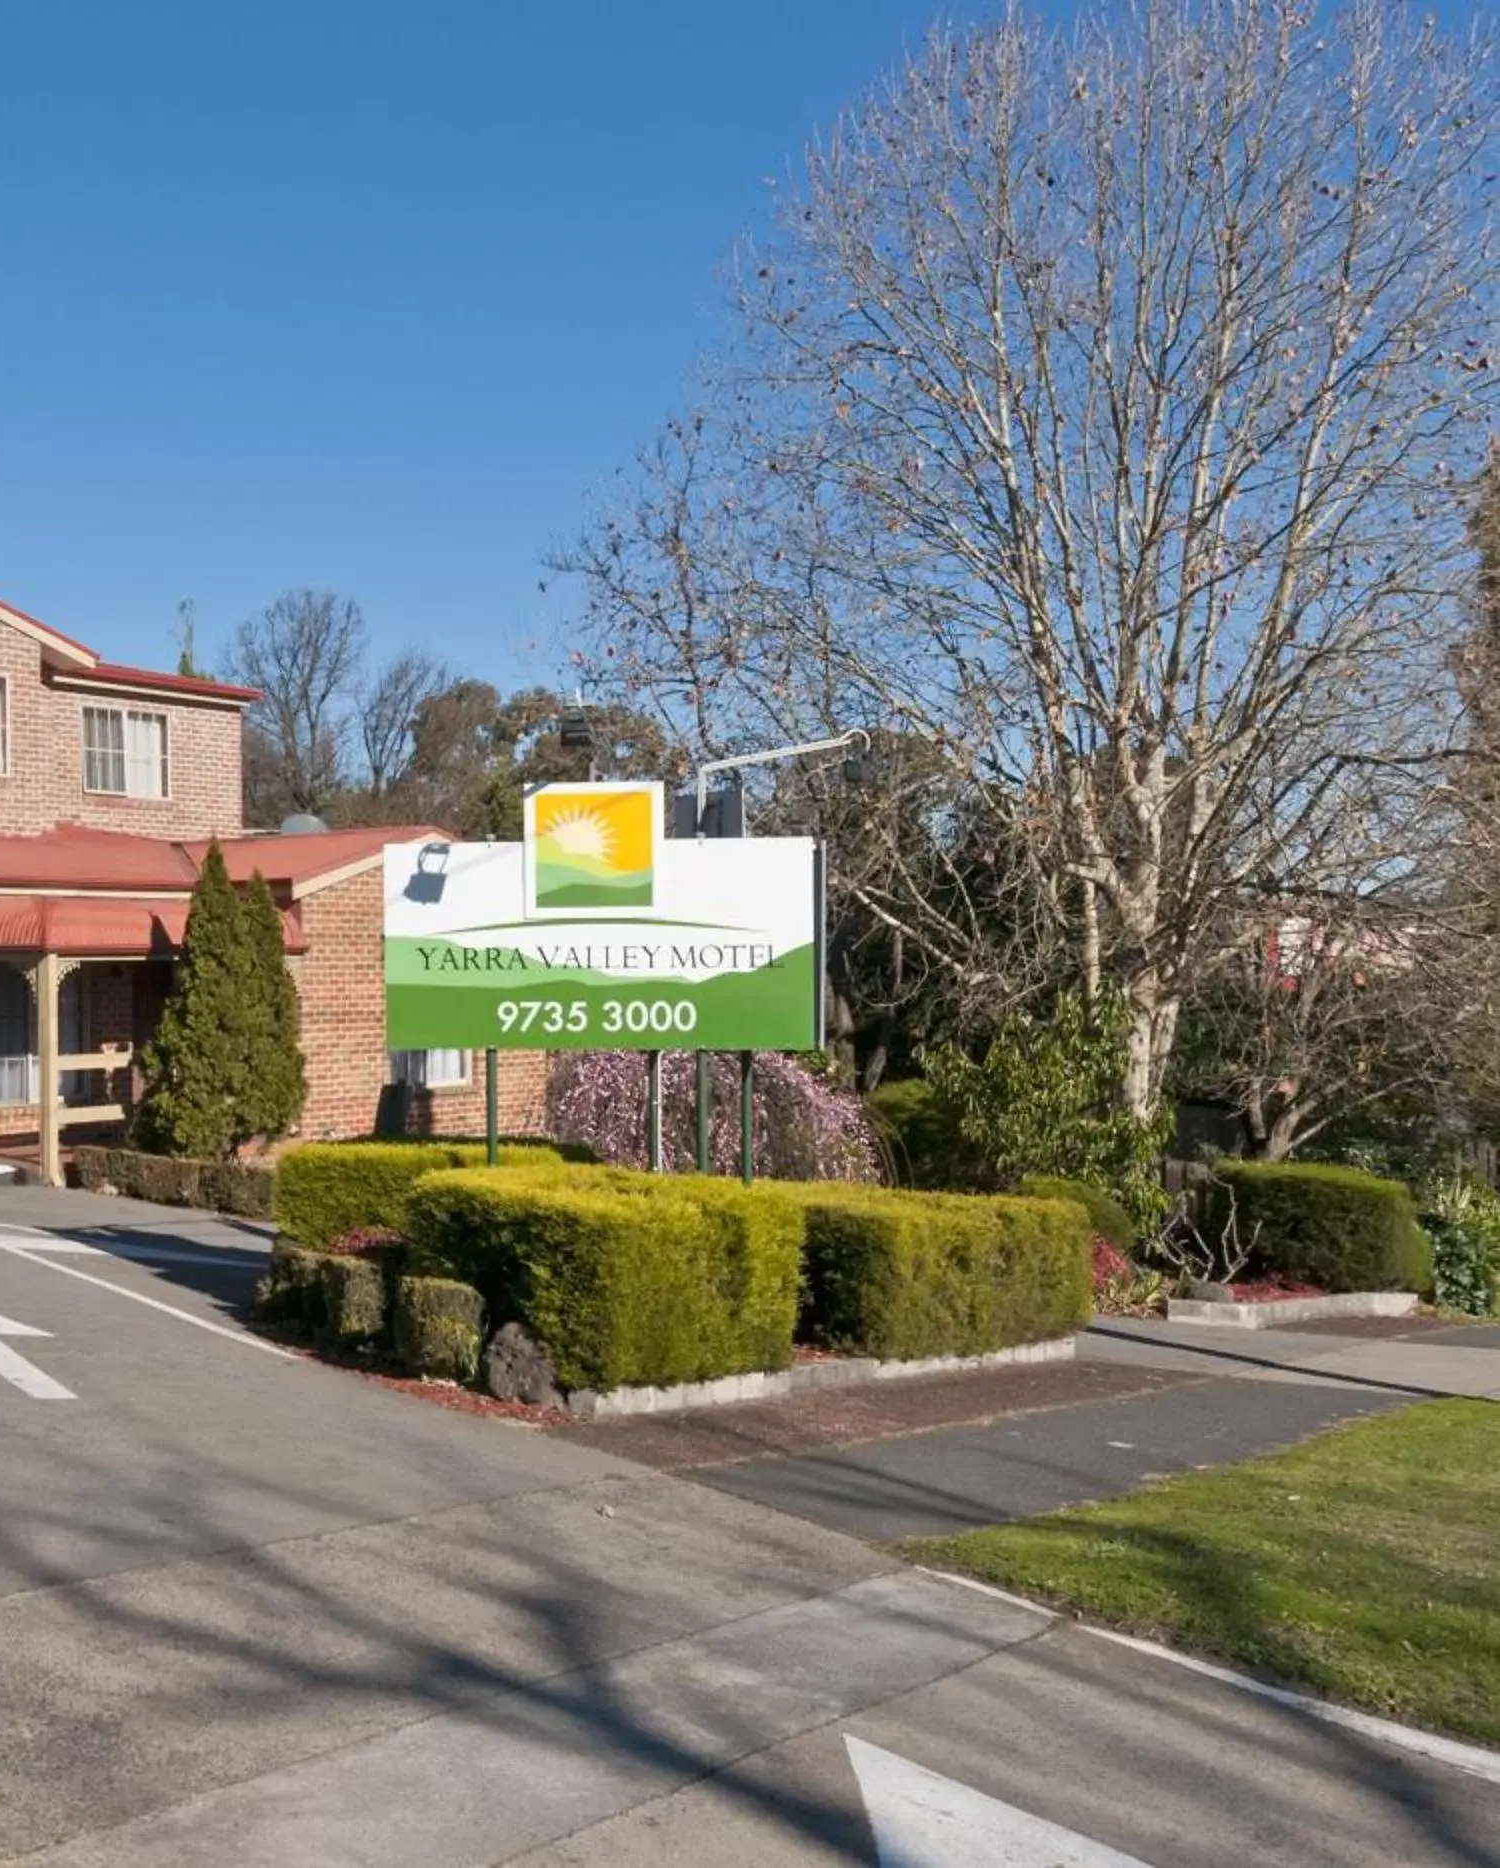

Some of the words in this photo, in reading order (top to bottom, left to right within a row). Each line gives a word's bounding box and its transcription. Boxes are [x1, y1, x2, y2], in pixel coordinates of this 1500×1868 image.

[416, 947, 528, 971] YARRA
[536, 945, 661, 970] VALLEY
[670, 943, 785, 970] MOTEL
[496, 1000, 588, 1033] 9735
[601, 1000, 698, 1033] 3000
